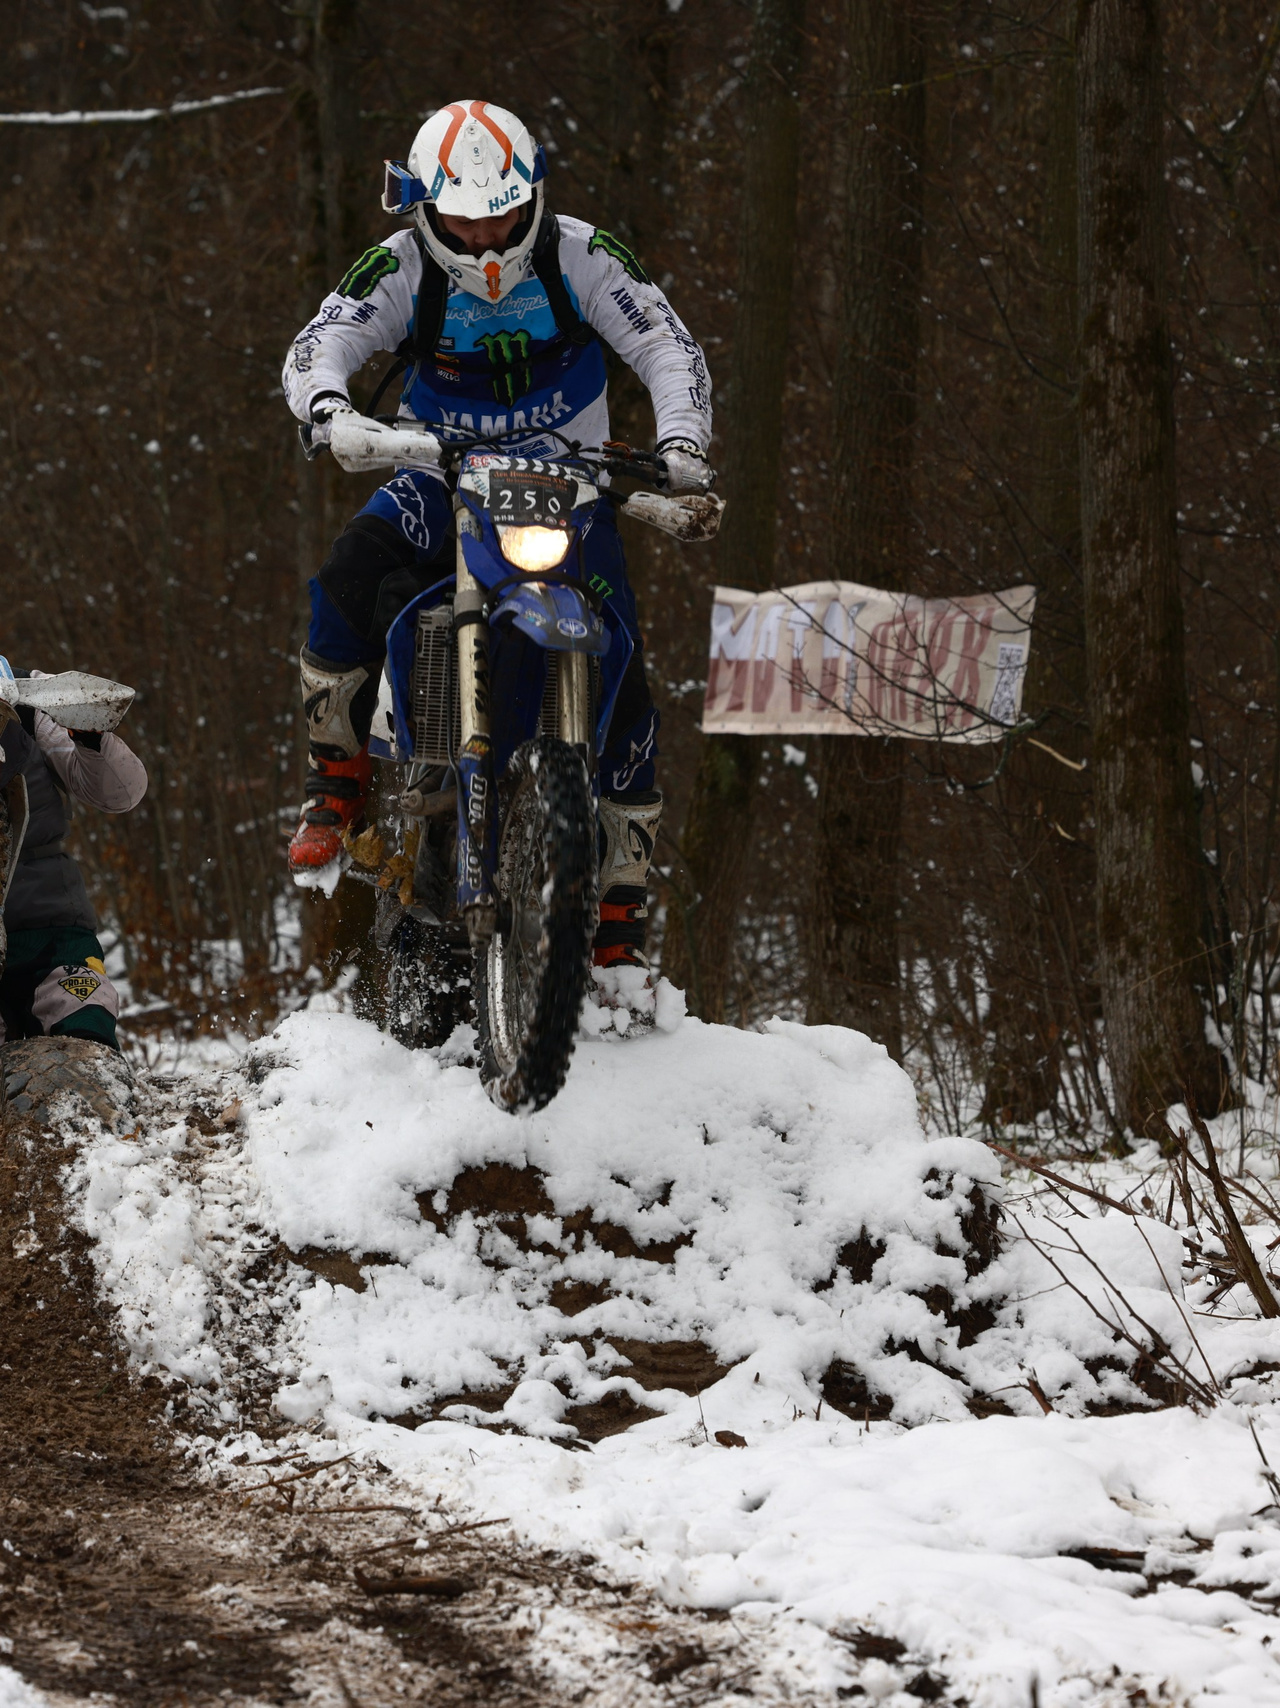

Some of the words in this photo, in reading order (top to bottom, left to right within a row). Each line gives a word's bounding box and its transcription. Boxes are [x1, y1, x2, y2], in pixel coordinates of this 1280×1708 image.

[488, 184, 521, 214] HJC
[495, 294, 549, 320] Designs
[436, 368, 460, 382] WILVO
[439, 390, 573, 441] YAMAHA
[499, 489, 561, 515] 250
